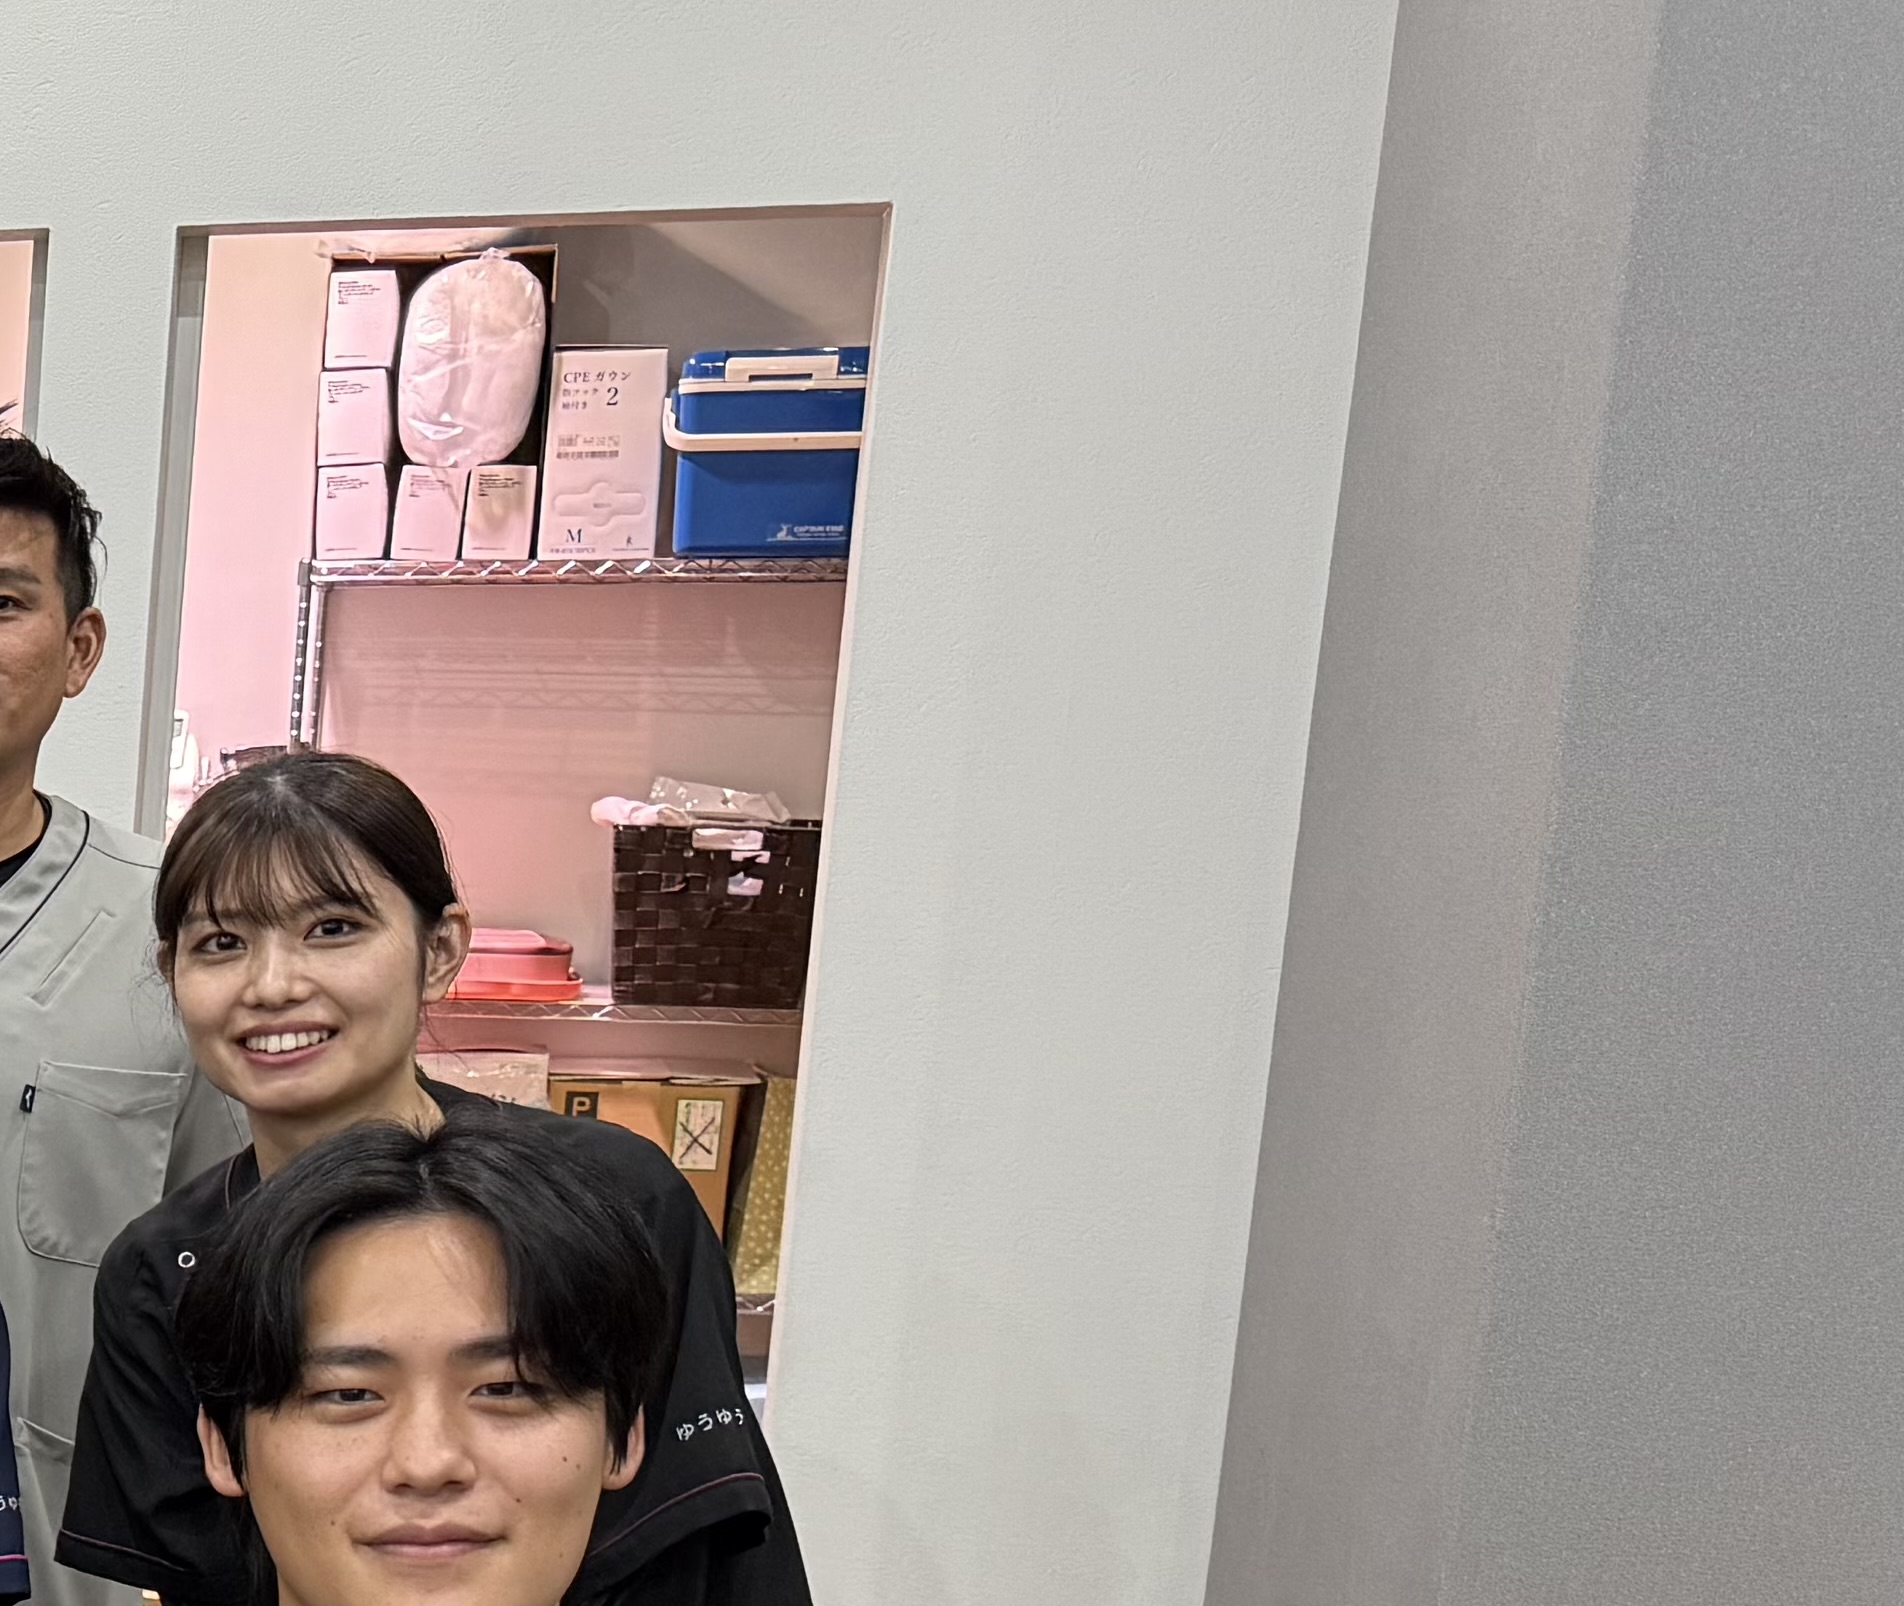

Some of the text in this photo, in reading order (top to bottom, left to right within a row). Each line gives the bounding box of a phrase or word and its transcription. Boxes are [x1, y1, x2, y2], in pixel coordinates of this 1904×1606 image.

[563, 370, 631, 383] CPE ガウン
[606, 386, 619, 406] 2
[566, 528, 582, 543] M
[572, 1097, 591, 1117] P
[676, 1409, 744, 1441] ゆうゆう
